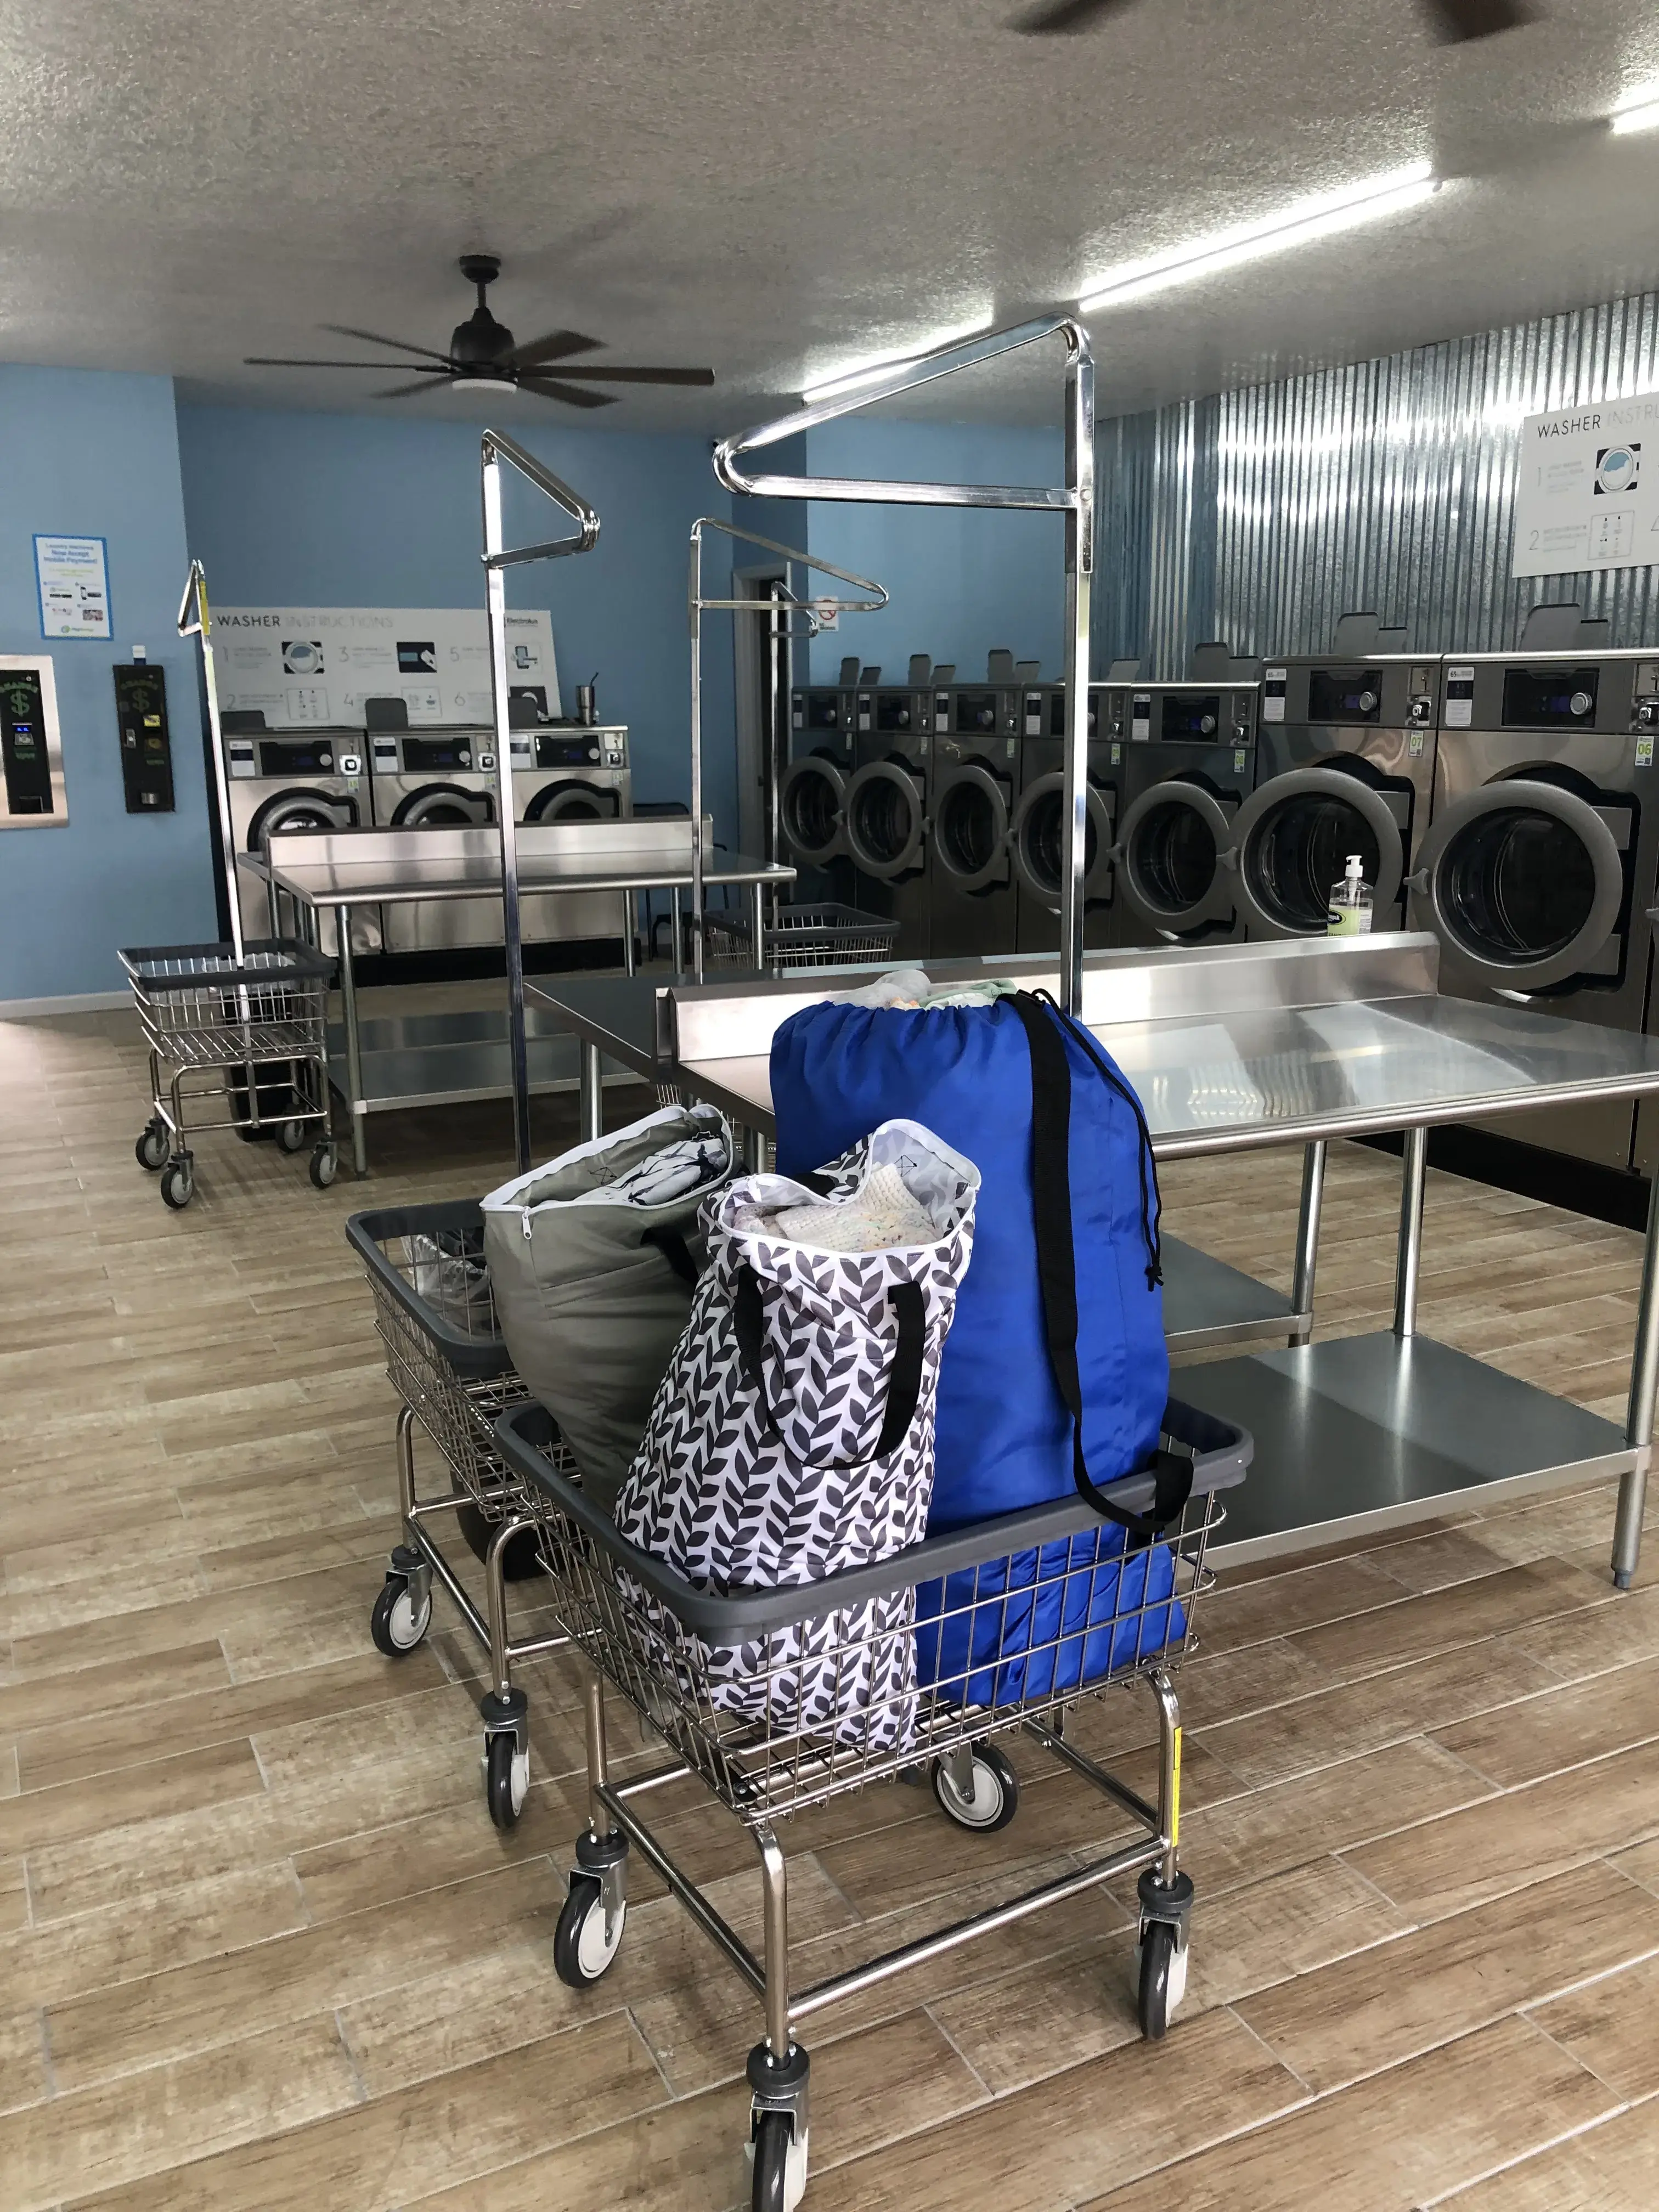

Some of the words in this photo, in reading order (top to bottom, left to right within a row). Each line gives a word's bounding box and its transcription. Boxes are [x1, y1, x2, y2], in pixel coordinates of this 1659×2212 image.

[1538, 414, 1600, 438] WASHER
[1529, 530, 1539, 550] 2
[217, 615, 281, 627] WASHER
[338, 646, 349, 662] 3
[450, 647, 460, 662] 5
[227, 693, 236, 710] 2
[343, 693, 354, 707] 4
[454, 692, 466, 707] 6
[1412, 736, 1422, 747] 07
[1638, 743, 1651, 755] 06
